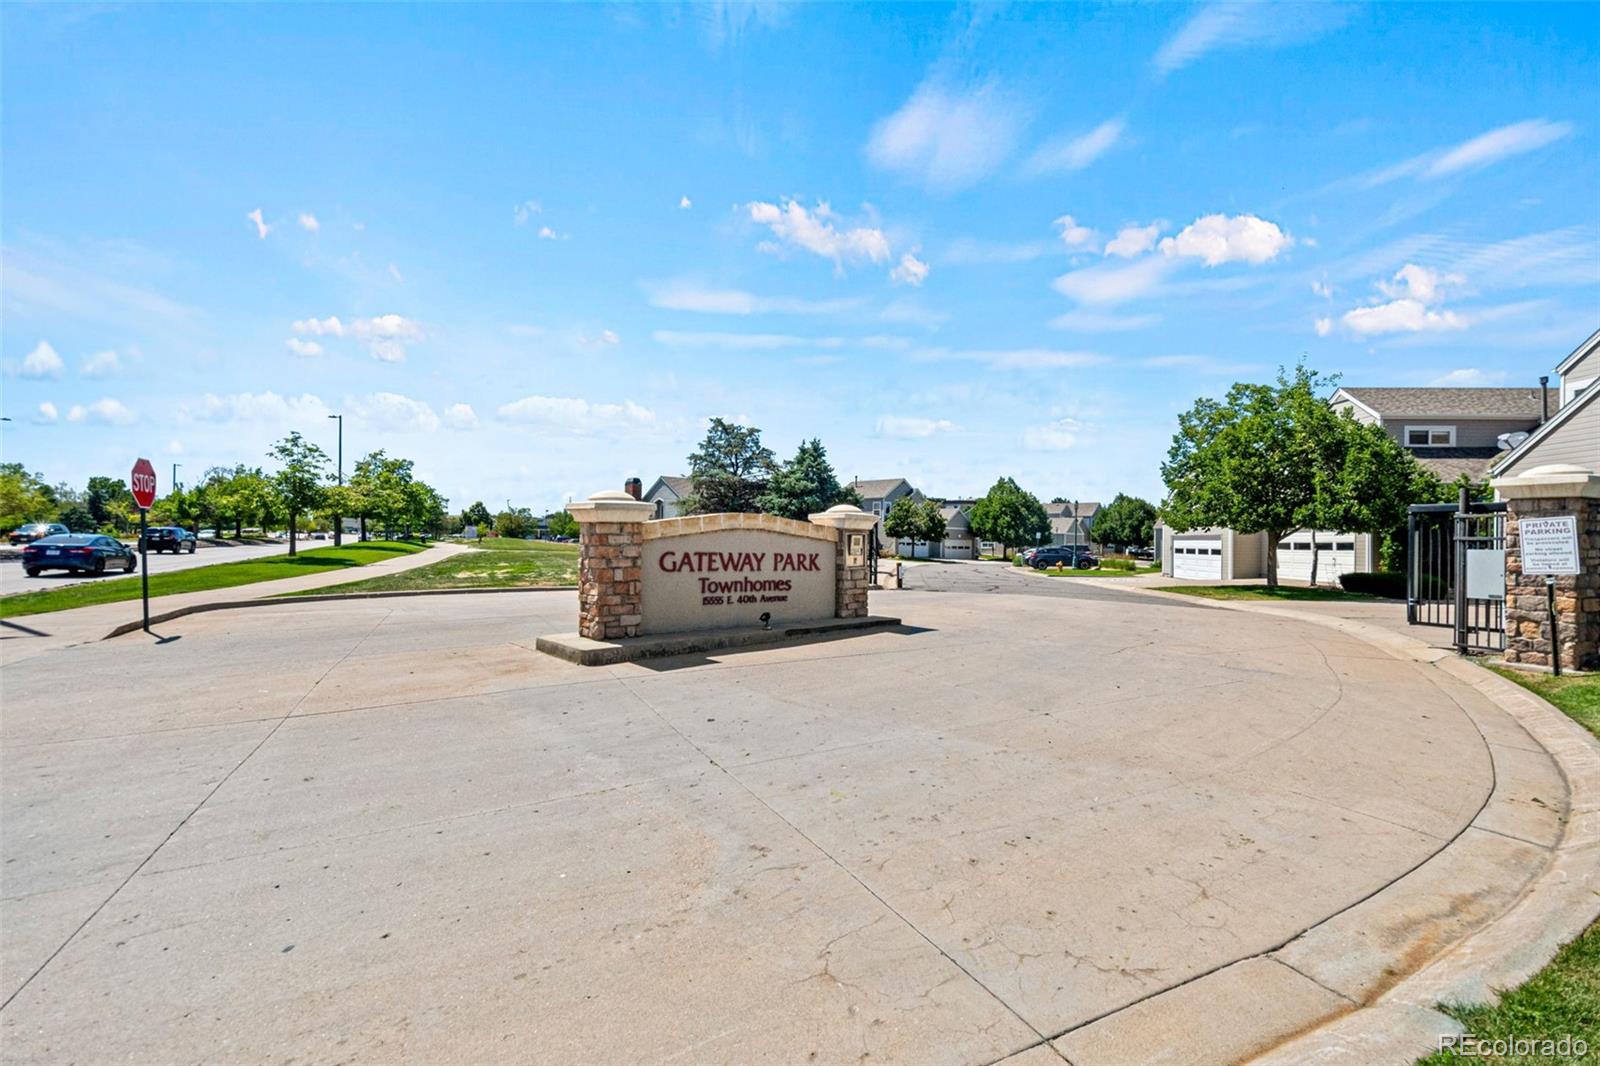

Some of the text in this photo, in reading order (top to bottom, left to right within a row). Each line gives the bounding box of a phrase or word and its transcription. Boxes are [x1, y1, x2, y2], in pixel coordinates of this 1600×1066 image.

[133, 473, 155, 493] STOP
[658, 551, 821, 573] GATEWAY PARK
[698, 576, 792, 594] Townhomes
[737, 594, 758, 604] 40th
[760, 594, 788, 603] Avenue
